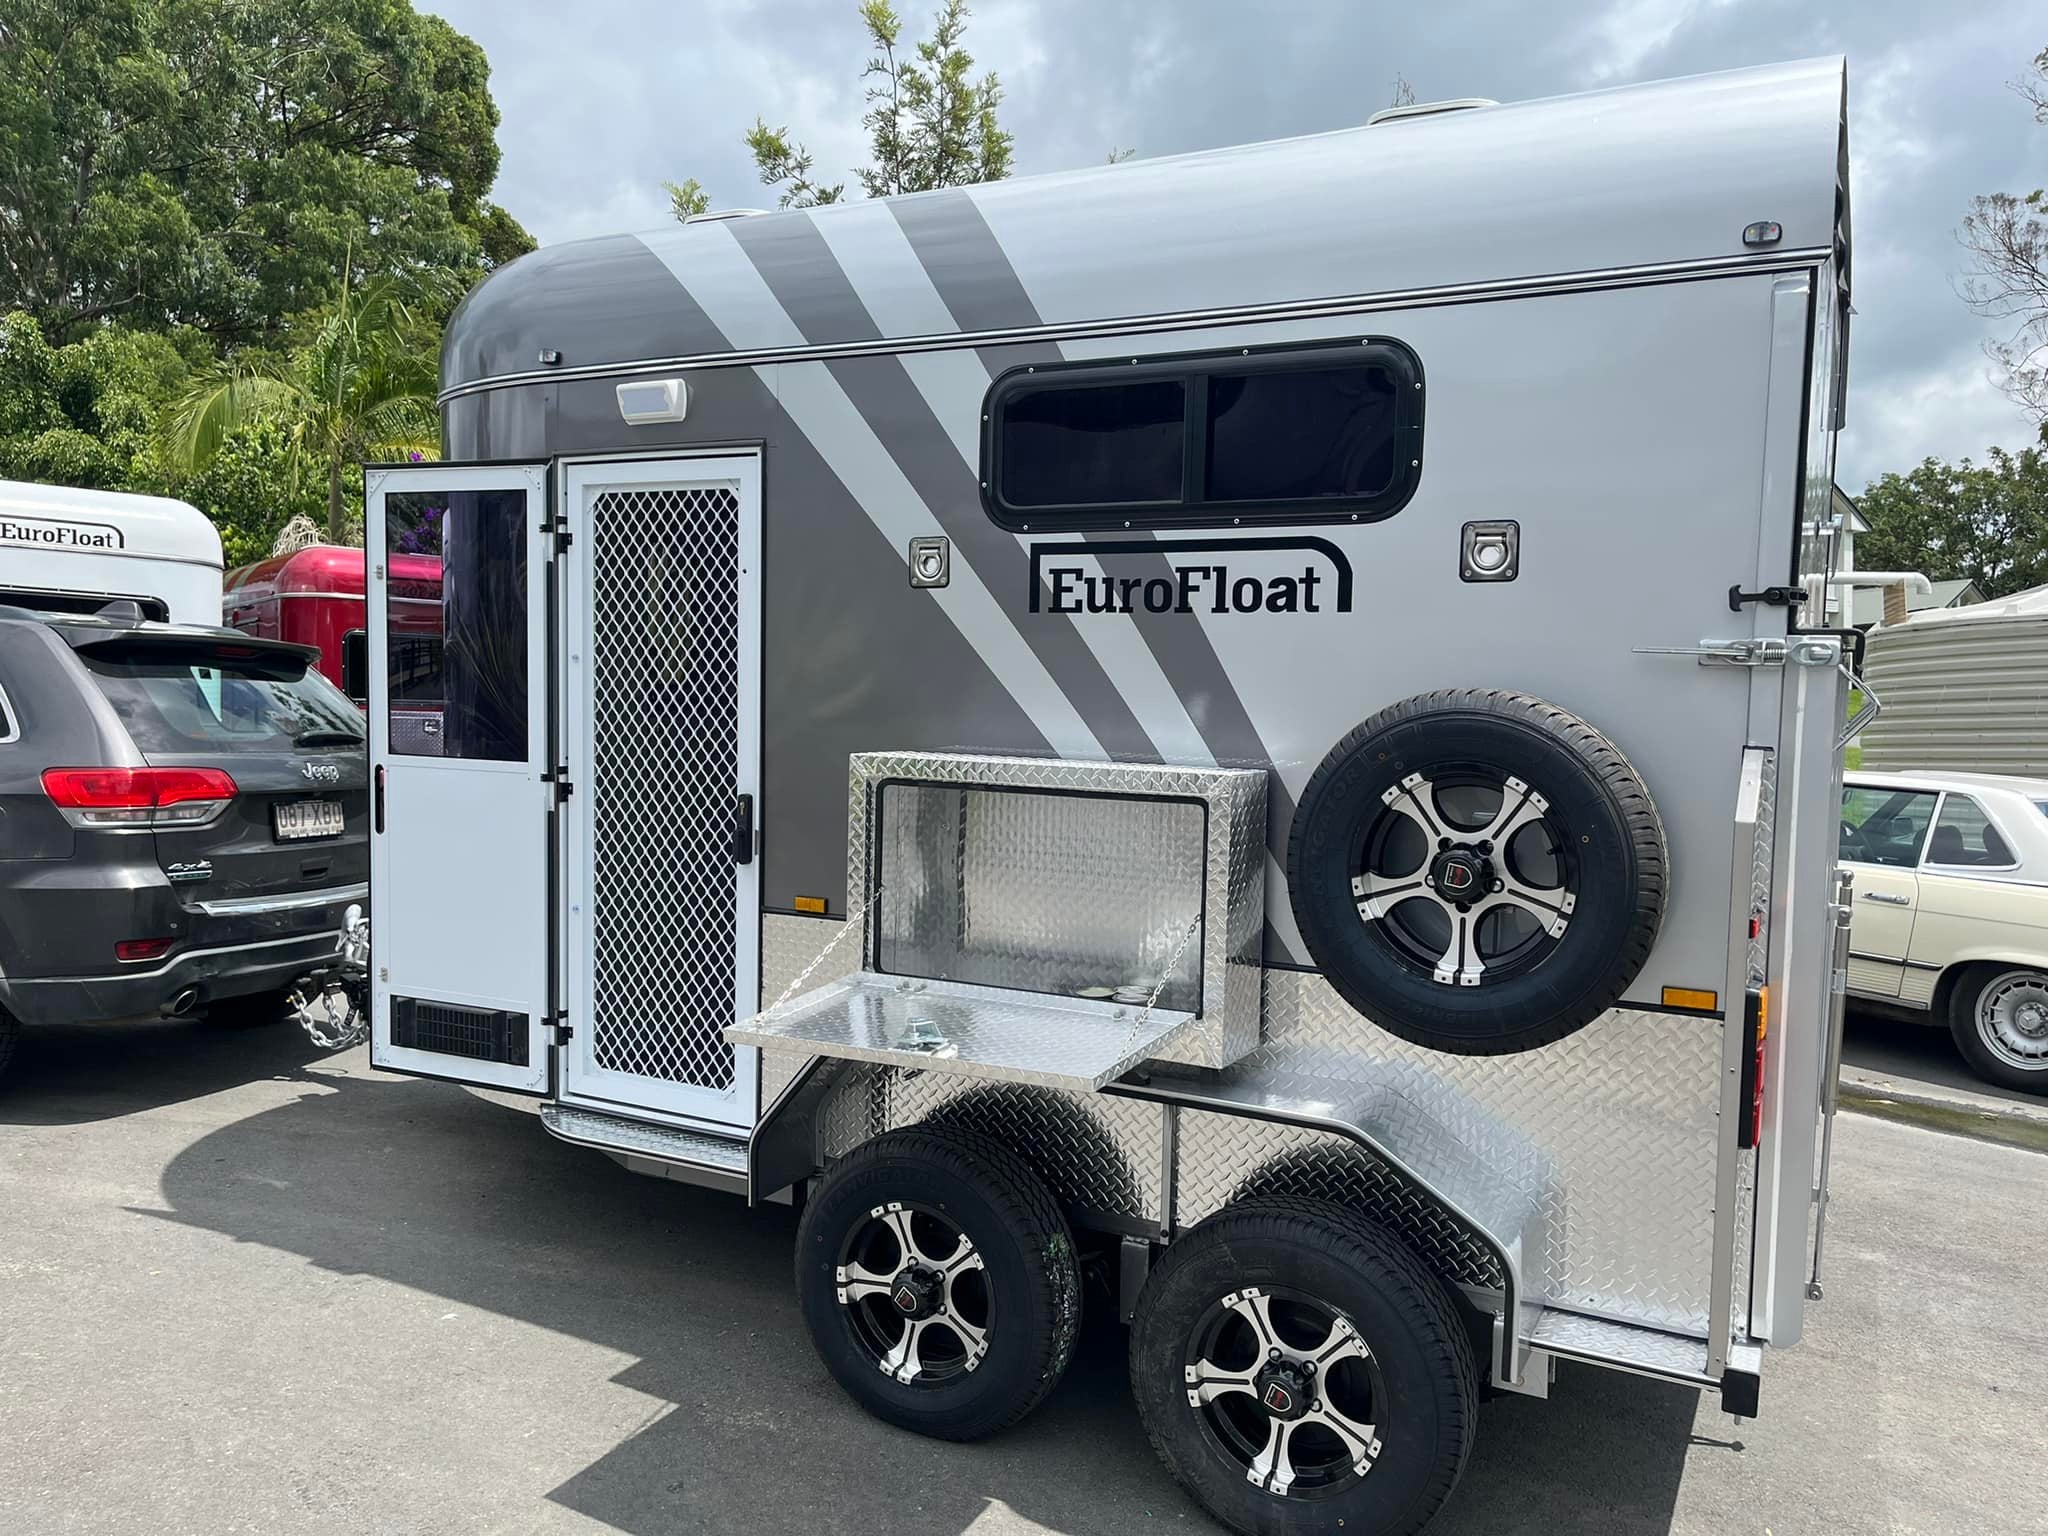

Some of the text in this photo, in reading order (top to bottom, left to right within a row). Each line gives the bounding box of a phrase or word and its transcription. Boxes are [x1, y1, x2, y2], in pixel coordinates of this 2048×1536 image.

[0, 522, 113, 548] EuroFloat
[1047, 566, 1321, 614] EuroFloat
[302, 761, 340, 783] Jeep
